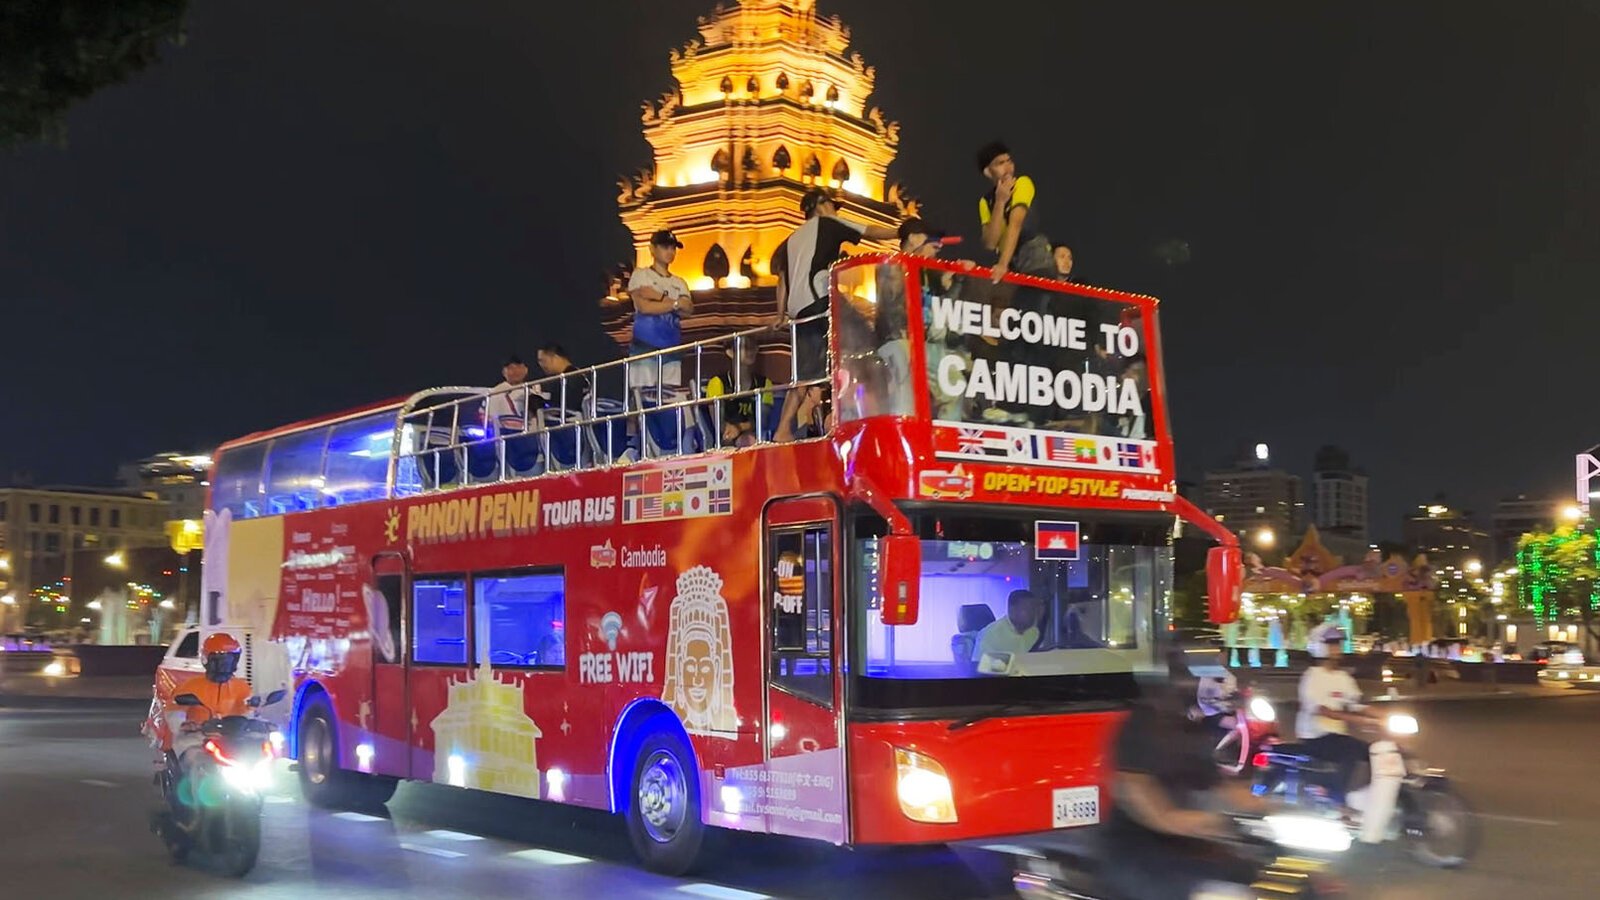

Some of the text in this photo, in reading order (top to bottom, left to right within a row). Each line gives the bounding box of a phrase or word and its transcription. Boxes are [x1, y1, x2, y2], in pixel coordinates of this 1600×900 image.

[931, 296, 1139, 357] WELCOME TO
[937, 354, 1144, 416] CAMBODIA
[983, 471, 1069, 496] OPEN-TOP
[1069, 478, 1121, 498] STYLE
[406, 489, 616, 543] PHNOM PENH TOUR BUS
[620, 545, 667, 568] Cambodia
[579, 651, 655, 684] FREE WIFI
